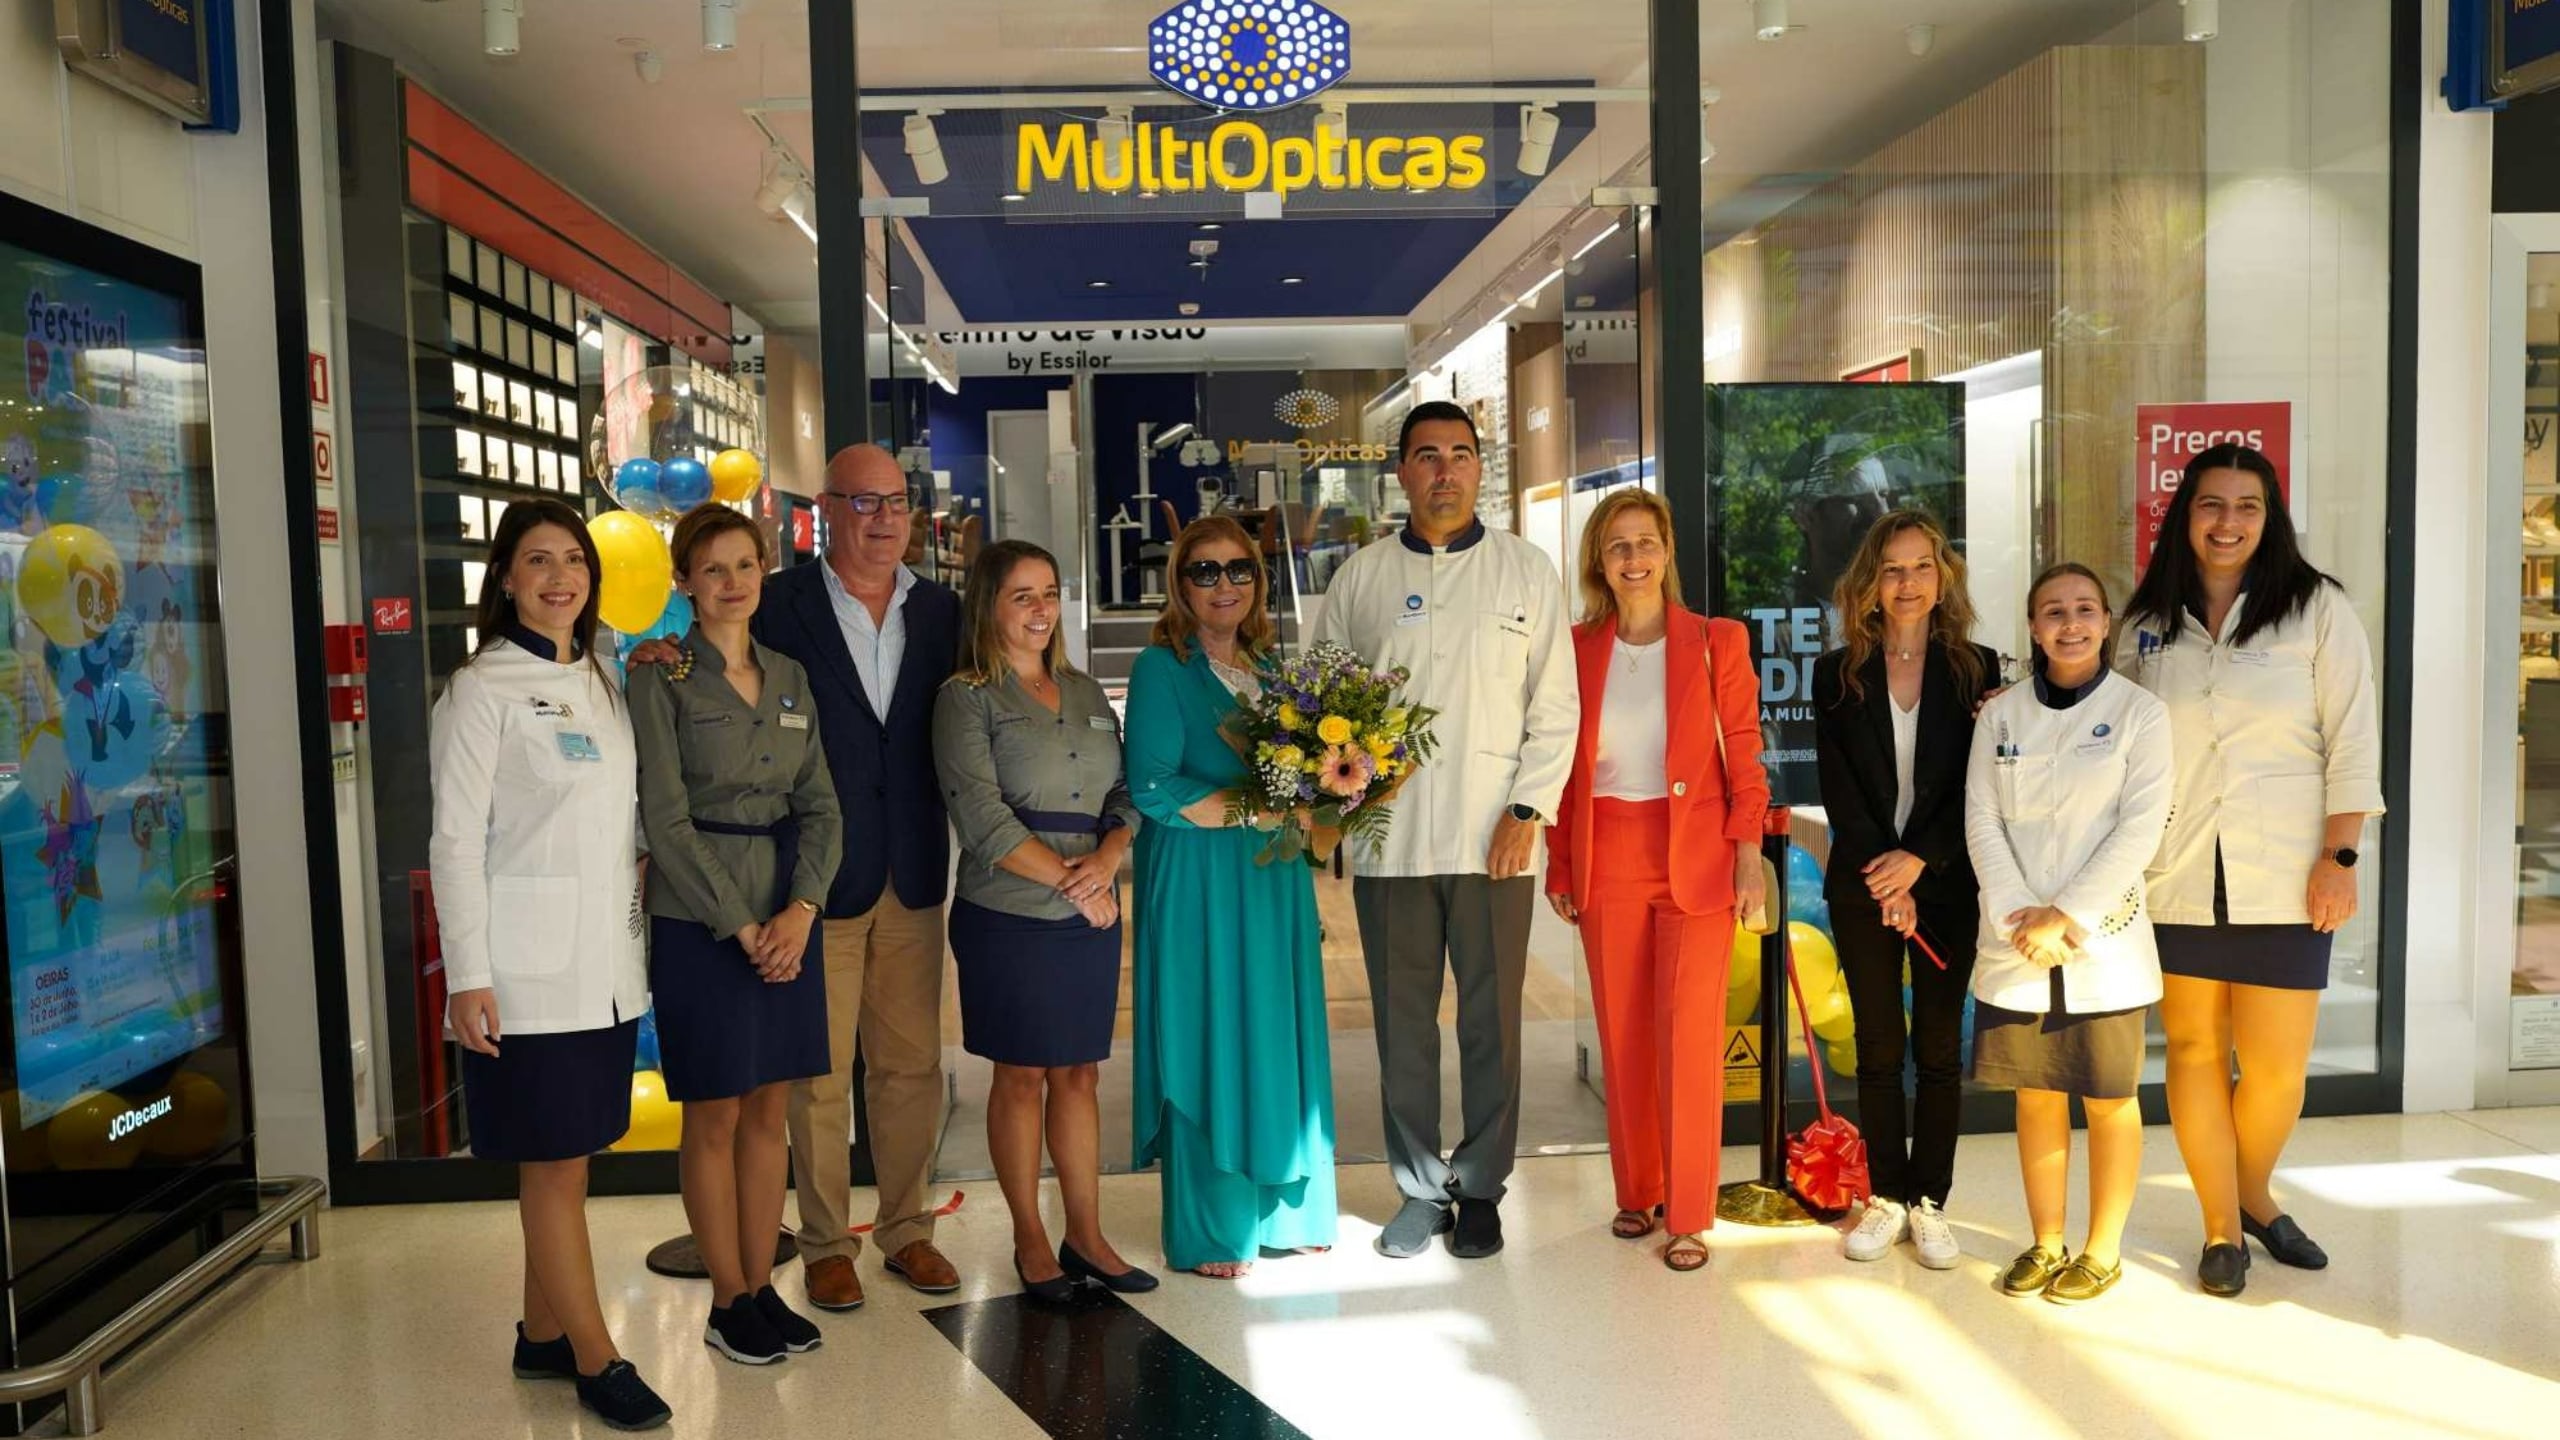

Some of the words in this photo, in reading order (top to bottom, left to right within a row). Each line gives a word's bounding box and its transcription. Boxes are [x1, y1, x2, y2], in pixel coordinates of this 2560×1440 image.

[1017, 121, 1487, 203] MultiOpticas
[28, 291, 125, 348] festival
[1008, 351, 1033, 374] by
[1040, 350, 1112, 370] Essilor
[1228, 438, 1387, 463] MOpticas
[108, 1095, 173, 1142] JCDecaux
